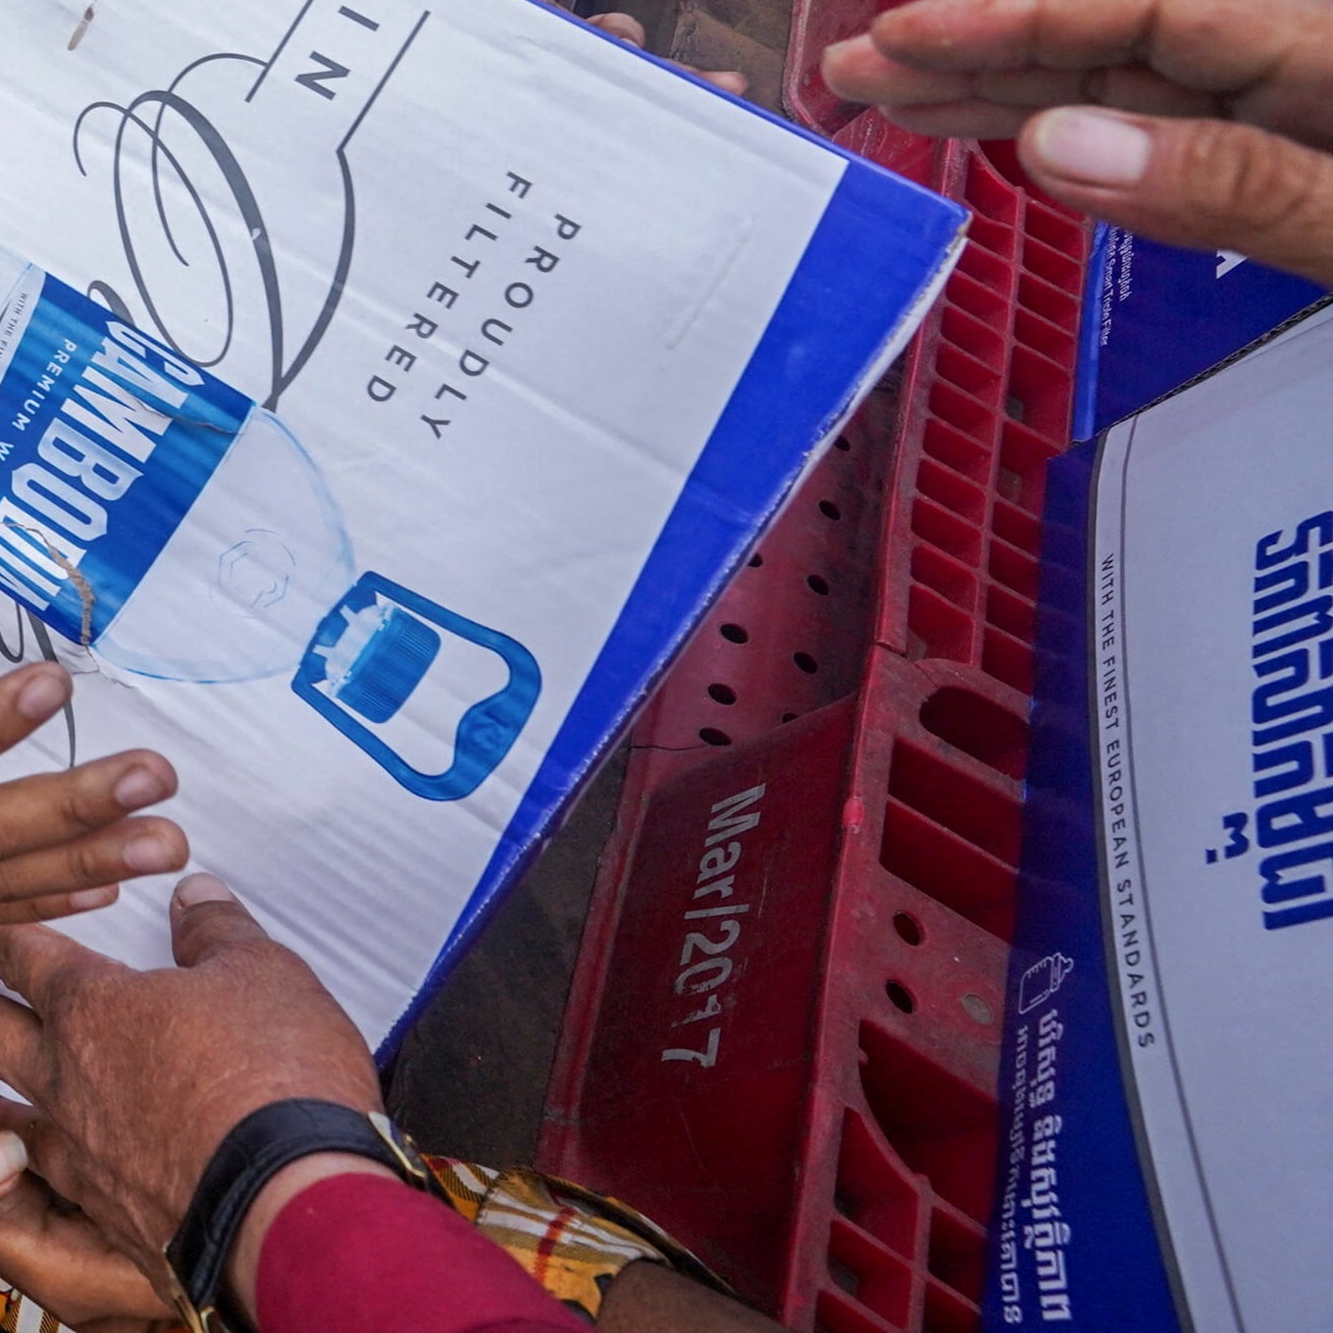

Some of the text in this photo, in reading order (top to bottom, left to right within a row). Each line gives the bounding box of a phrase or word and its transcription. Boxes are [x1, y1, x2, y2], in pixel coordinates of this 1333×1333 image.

[293, 4, 382, 101] IN
[4, 317, 20, 338] THE
[12, 291, 30, 318] WITH
[366, 169, 533, 405] FILTERED
[419, 211, 583, 441] PROUDLY
[11, 337, 78, 433] PREMIUM
[1101, 553, 1156, 1050] WITH THE FINEST EUROPEAN STANDARDS
[660, 782, 767, 1068] Mar/2017
